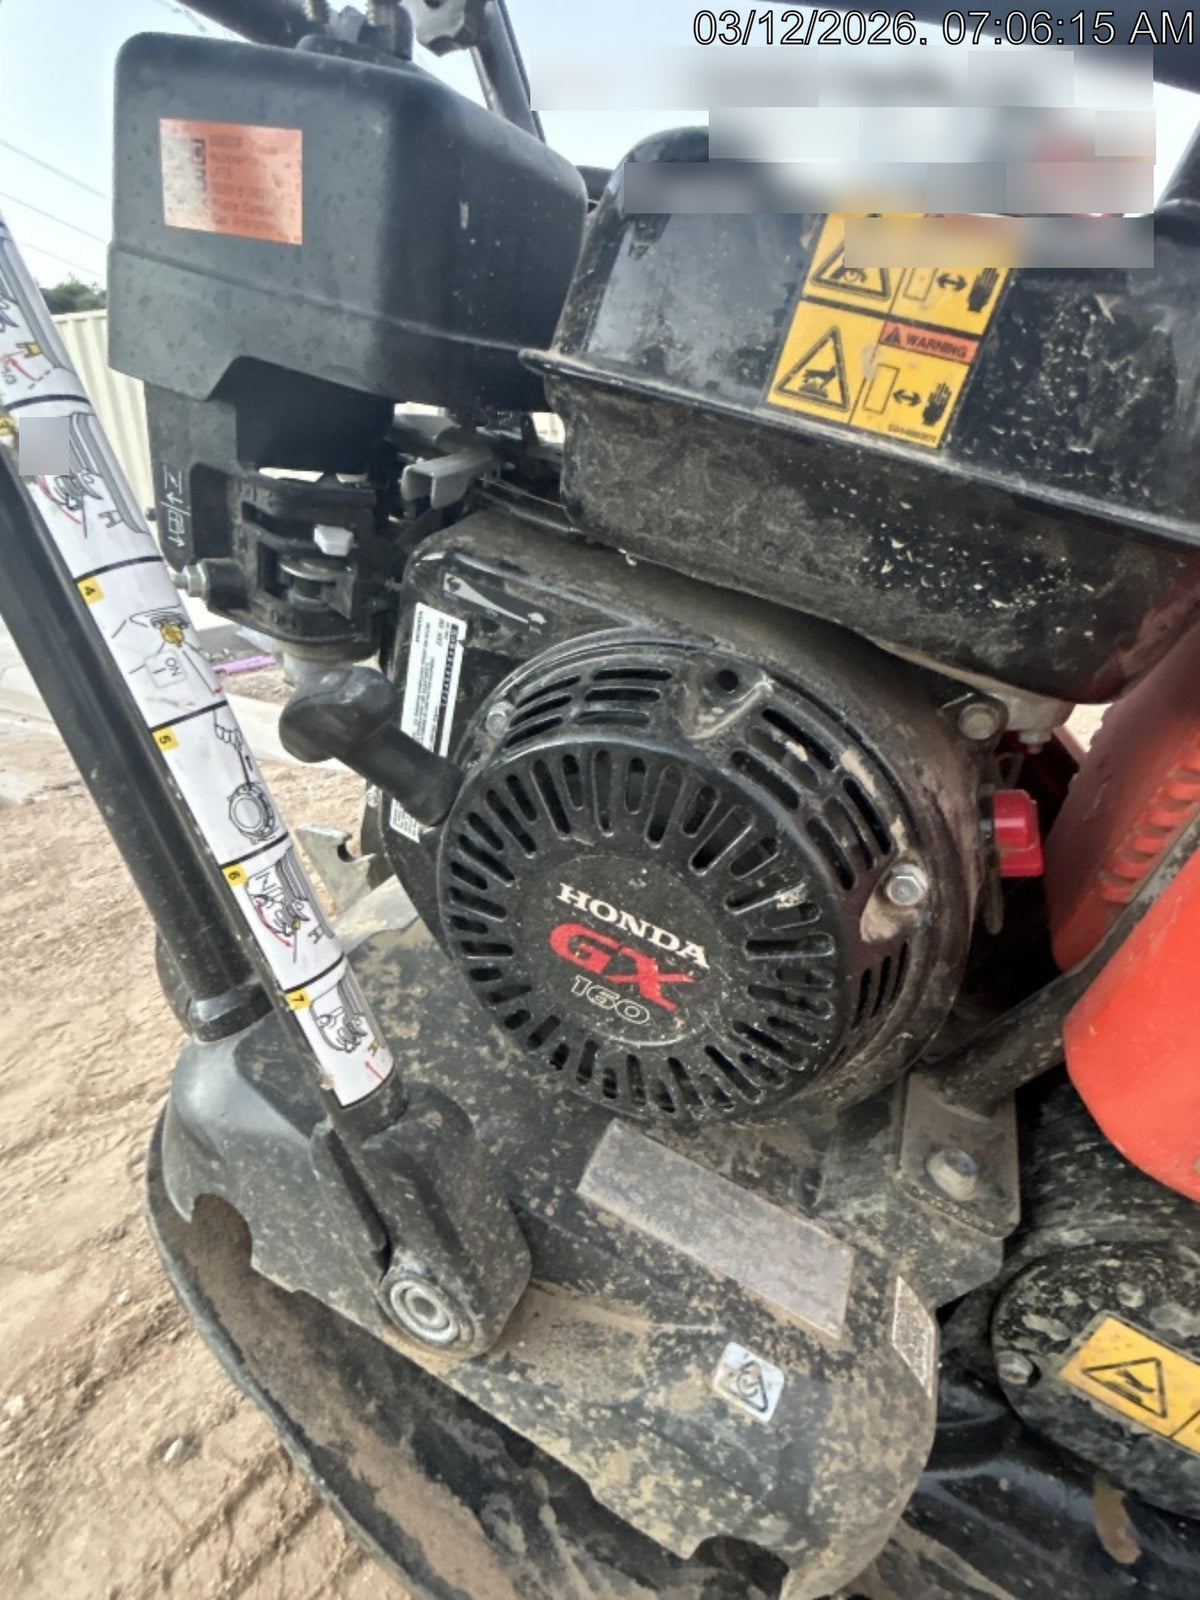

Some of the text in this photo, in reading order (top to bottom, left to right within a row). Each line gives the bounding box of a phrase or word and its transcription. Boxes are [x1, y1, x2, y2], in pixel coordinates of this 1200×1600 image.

[905, 335, 968, 358] WARNING
[165, 656, 182, 677] ON
[556, 882, 710, 970] HONDA
[548, 922, 695, 1012] GX
[570, 974, 650, 1024] 160
